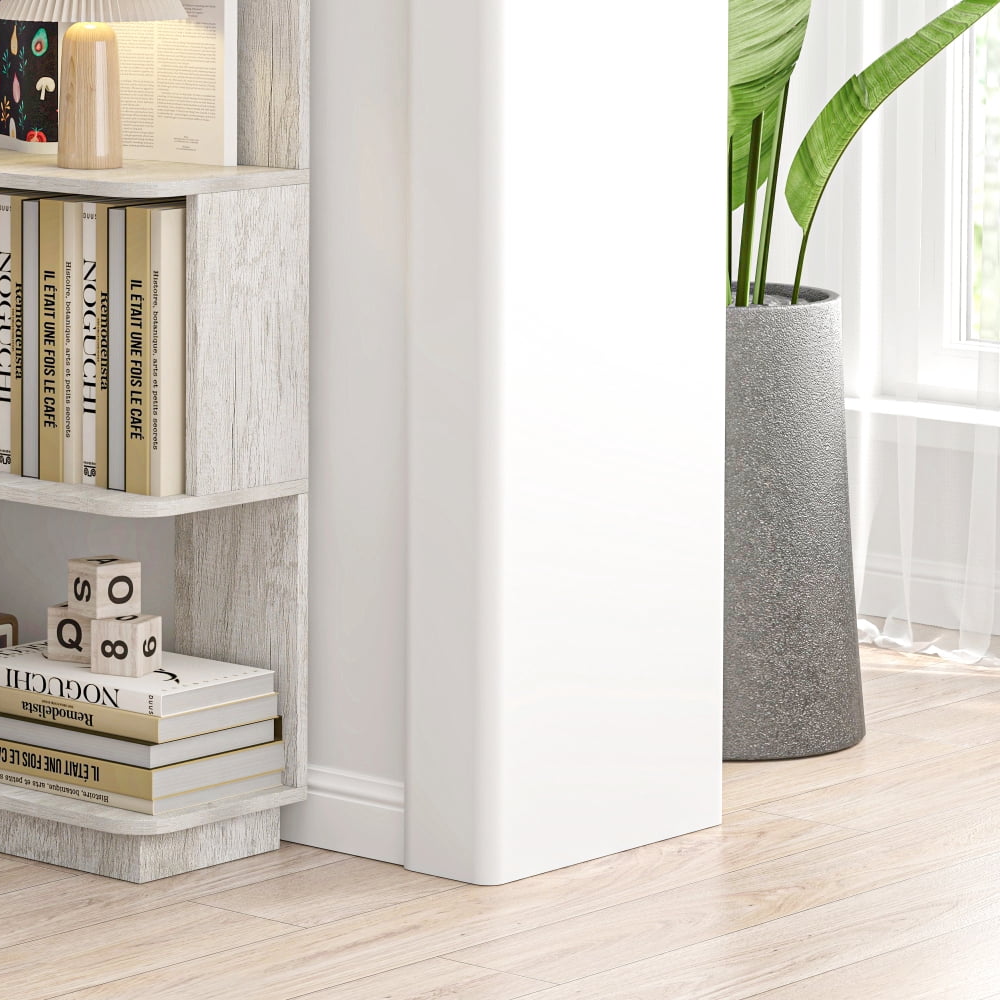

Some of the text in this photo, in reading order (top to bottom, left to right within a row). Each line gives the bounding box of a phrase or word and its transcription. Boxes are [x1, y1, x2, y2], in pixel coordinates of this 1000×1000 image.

[43, 270, 58, 428] IL ÉTAIT UNE FOIS LE CAFÉ
[83, 258, 97, 414] NOGUCHI
[130, 279, 145, 441] IL ÉTAIT UNE FOIS LE CAFÉ
[73, 577, 92, 603] S
[56, 618, 83, 653] Q
[100, 639, 129, 660] 8
[5, 667, 120, 709] NOGUCHI
[21, 700, 94, 727] Remodelista
